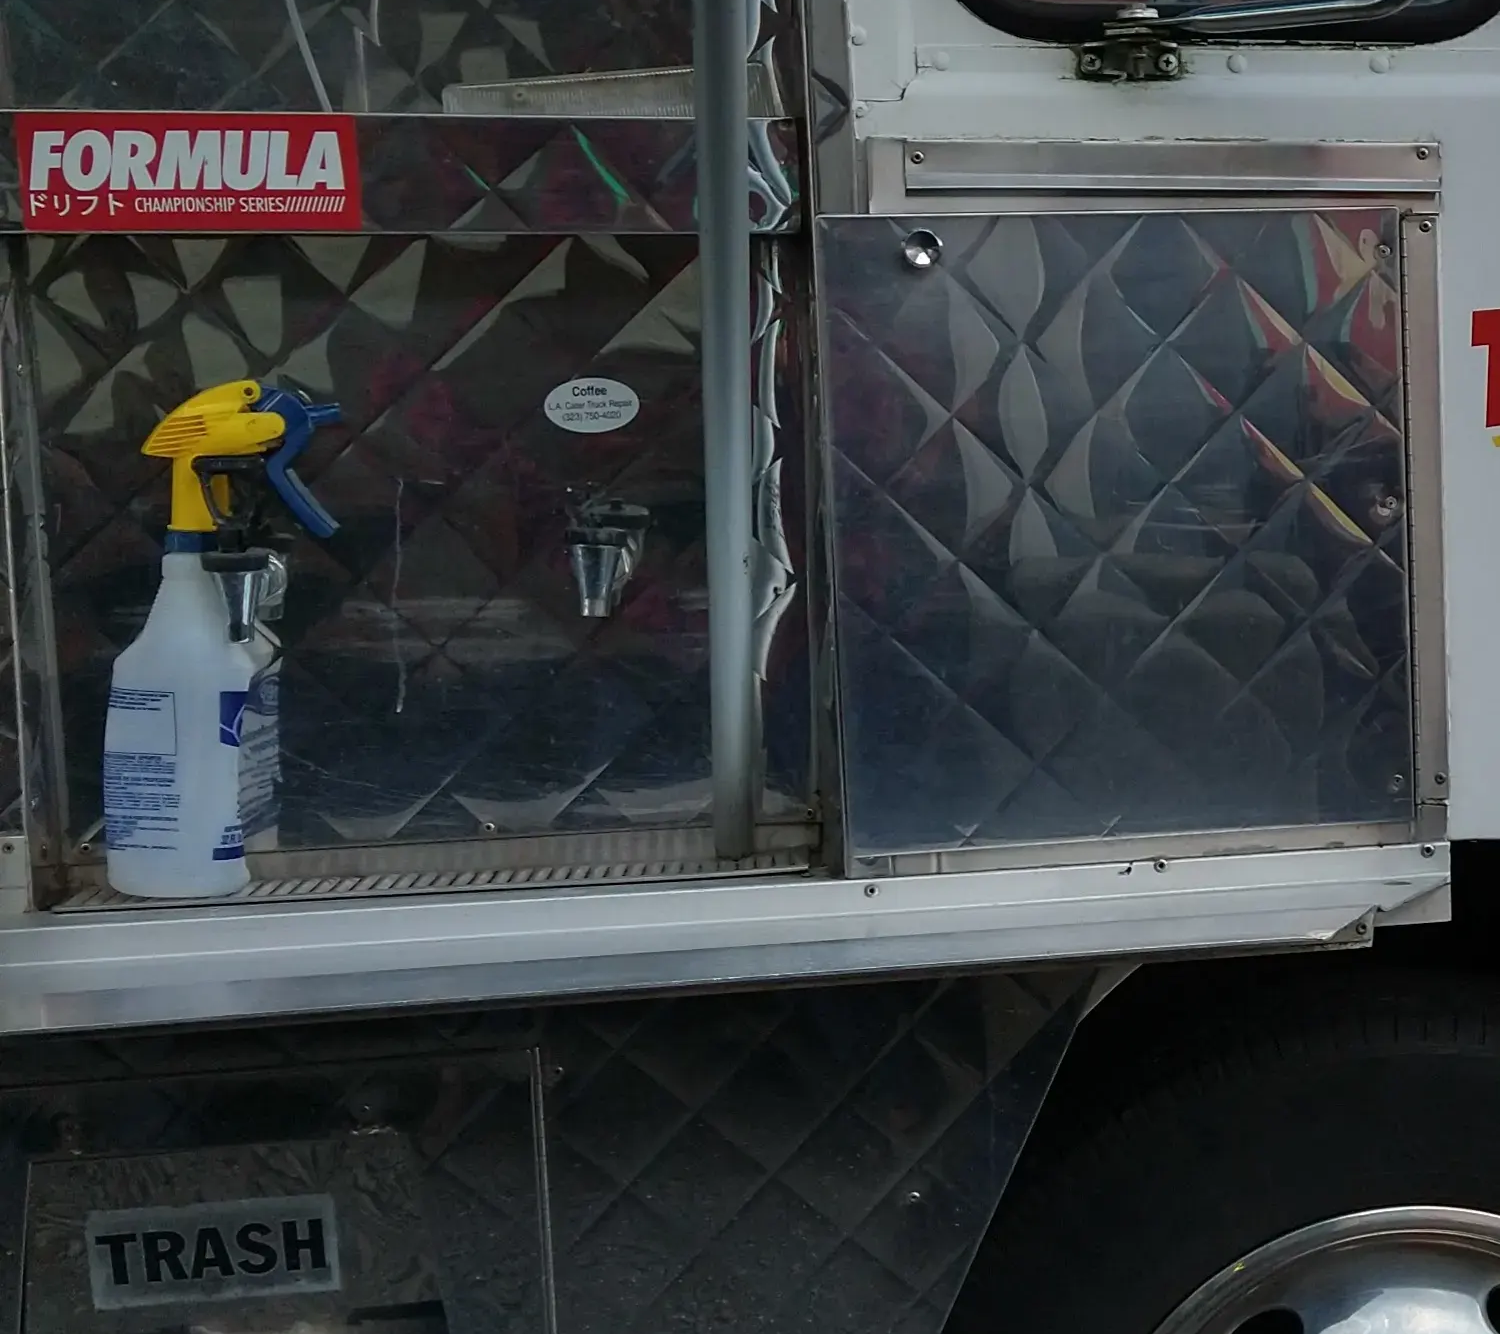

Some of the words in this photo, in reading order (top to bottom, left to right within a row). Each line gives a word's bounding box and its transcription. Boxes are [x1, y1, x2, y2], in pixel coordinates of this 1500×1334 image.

[30, 129, 345, 192] FORMULA
[30, 193, 124, 217] ドリフト
[134, 196, 235, 213] CHAMPIONSHIP
[572, 386, 608, 397] Coffee
[95, 1218, 327, 1285] TRASH
